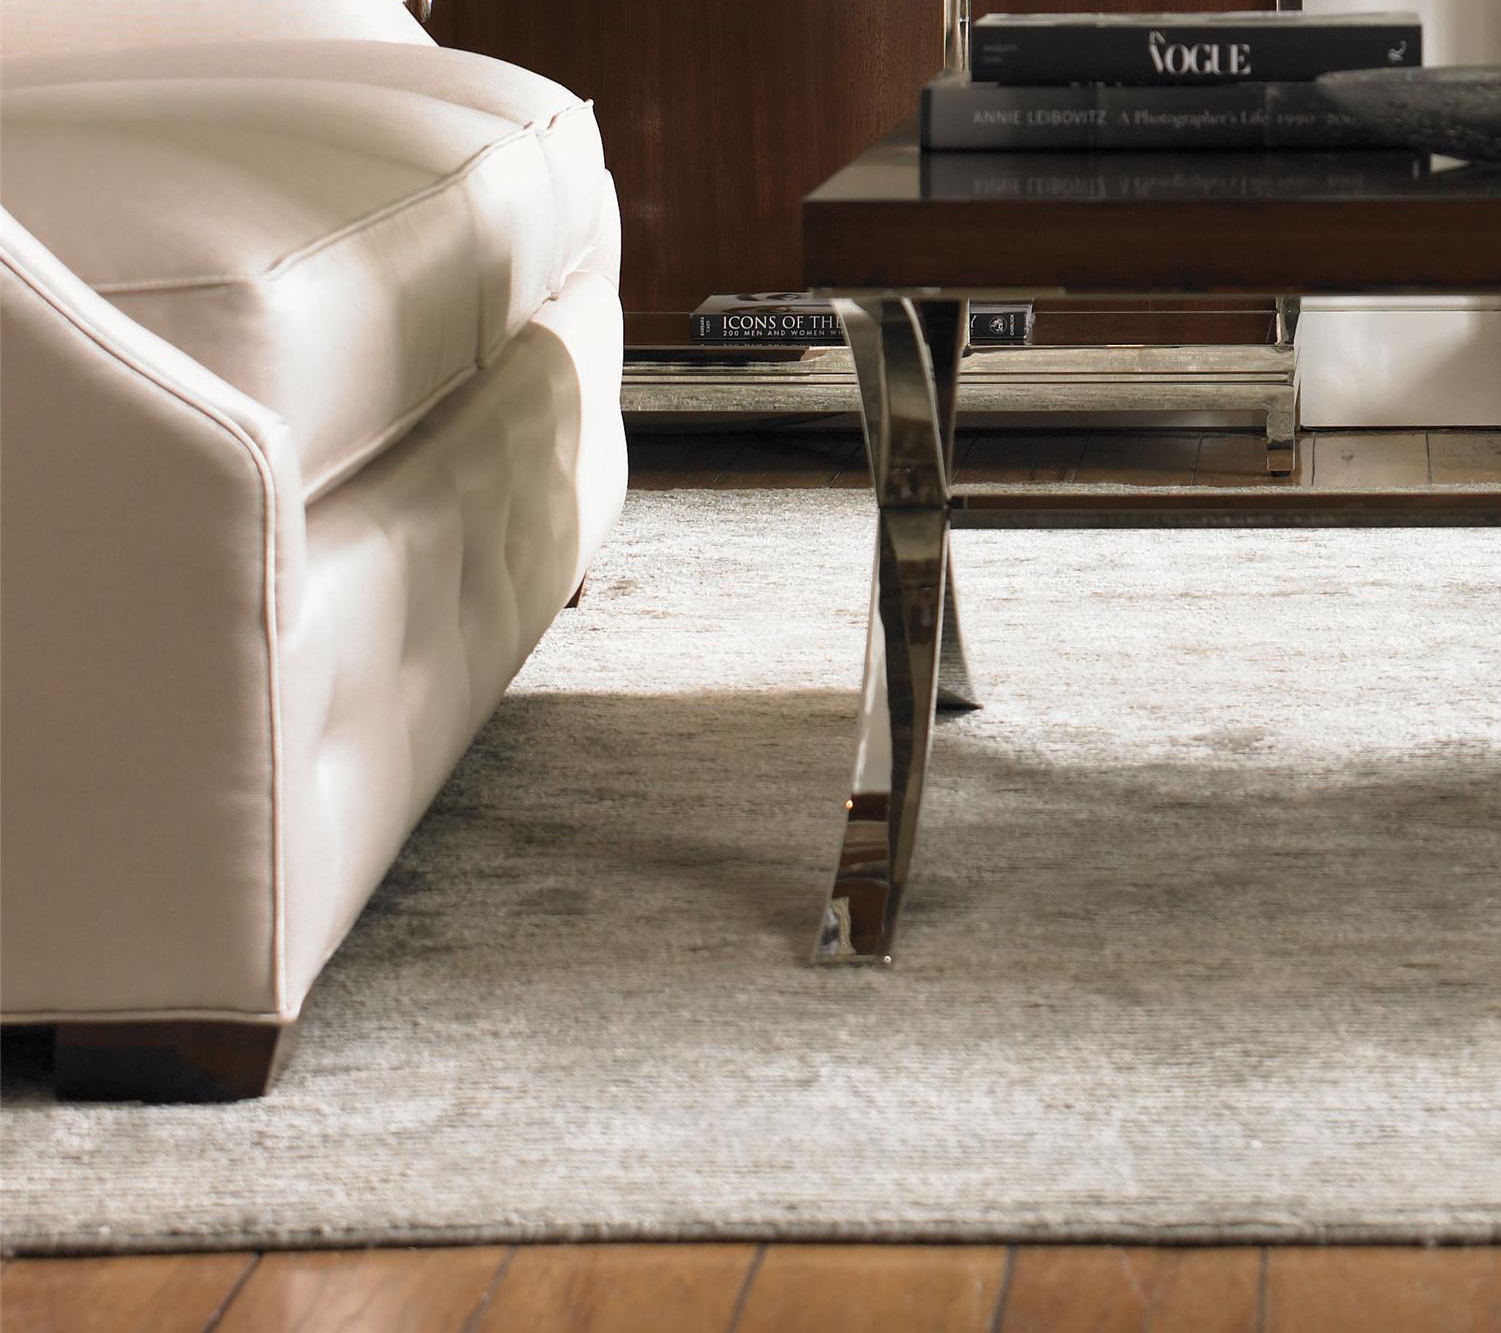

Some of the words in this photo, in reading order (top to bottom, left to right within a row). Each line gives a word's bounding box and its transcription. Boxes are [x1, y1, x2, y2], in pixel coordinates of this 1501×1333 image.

[1148, 42, 1252, 76] VOGUE
[973, 109, 1021, 125] ANNIE
[1026, 109, 1108, 125] LEIBOVITZ
[1118, 110, 1131, 125] A
[1134, 108, 1238, 128] Photographer's
[1240, 108, 1269, 125] Life
[722, 315, 777, 330] ICONS
[782, 315, 805, 330] OF
[808, 315, 842, 330] THE
[722, 329, 740, 337] 200
[743, 329, 763, 337] MEN
[767, 329, 786, 337] AND
[790, 329, 825, 337] WOMEN
